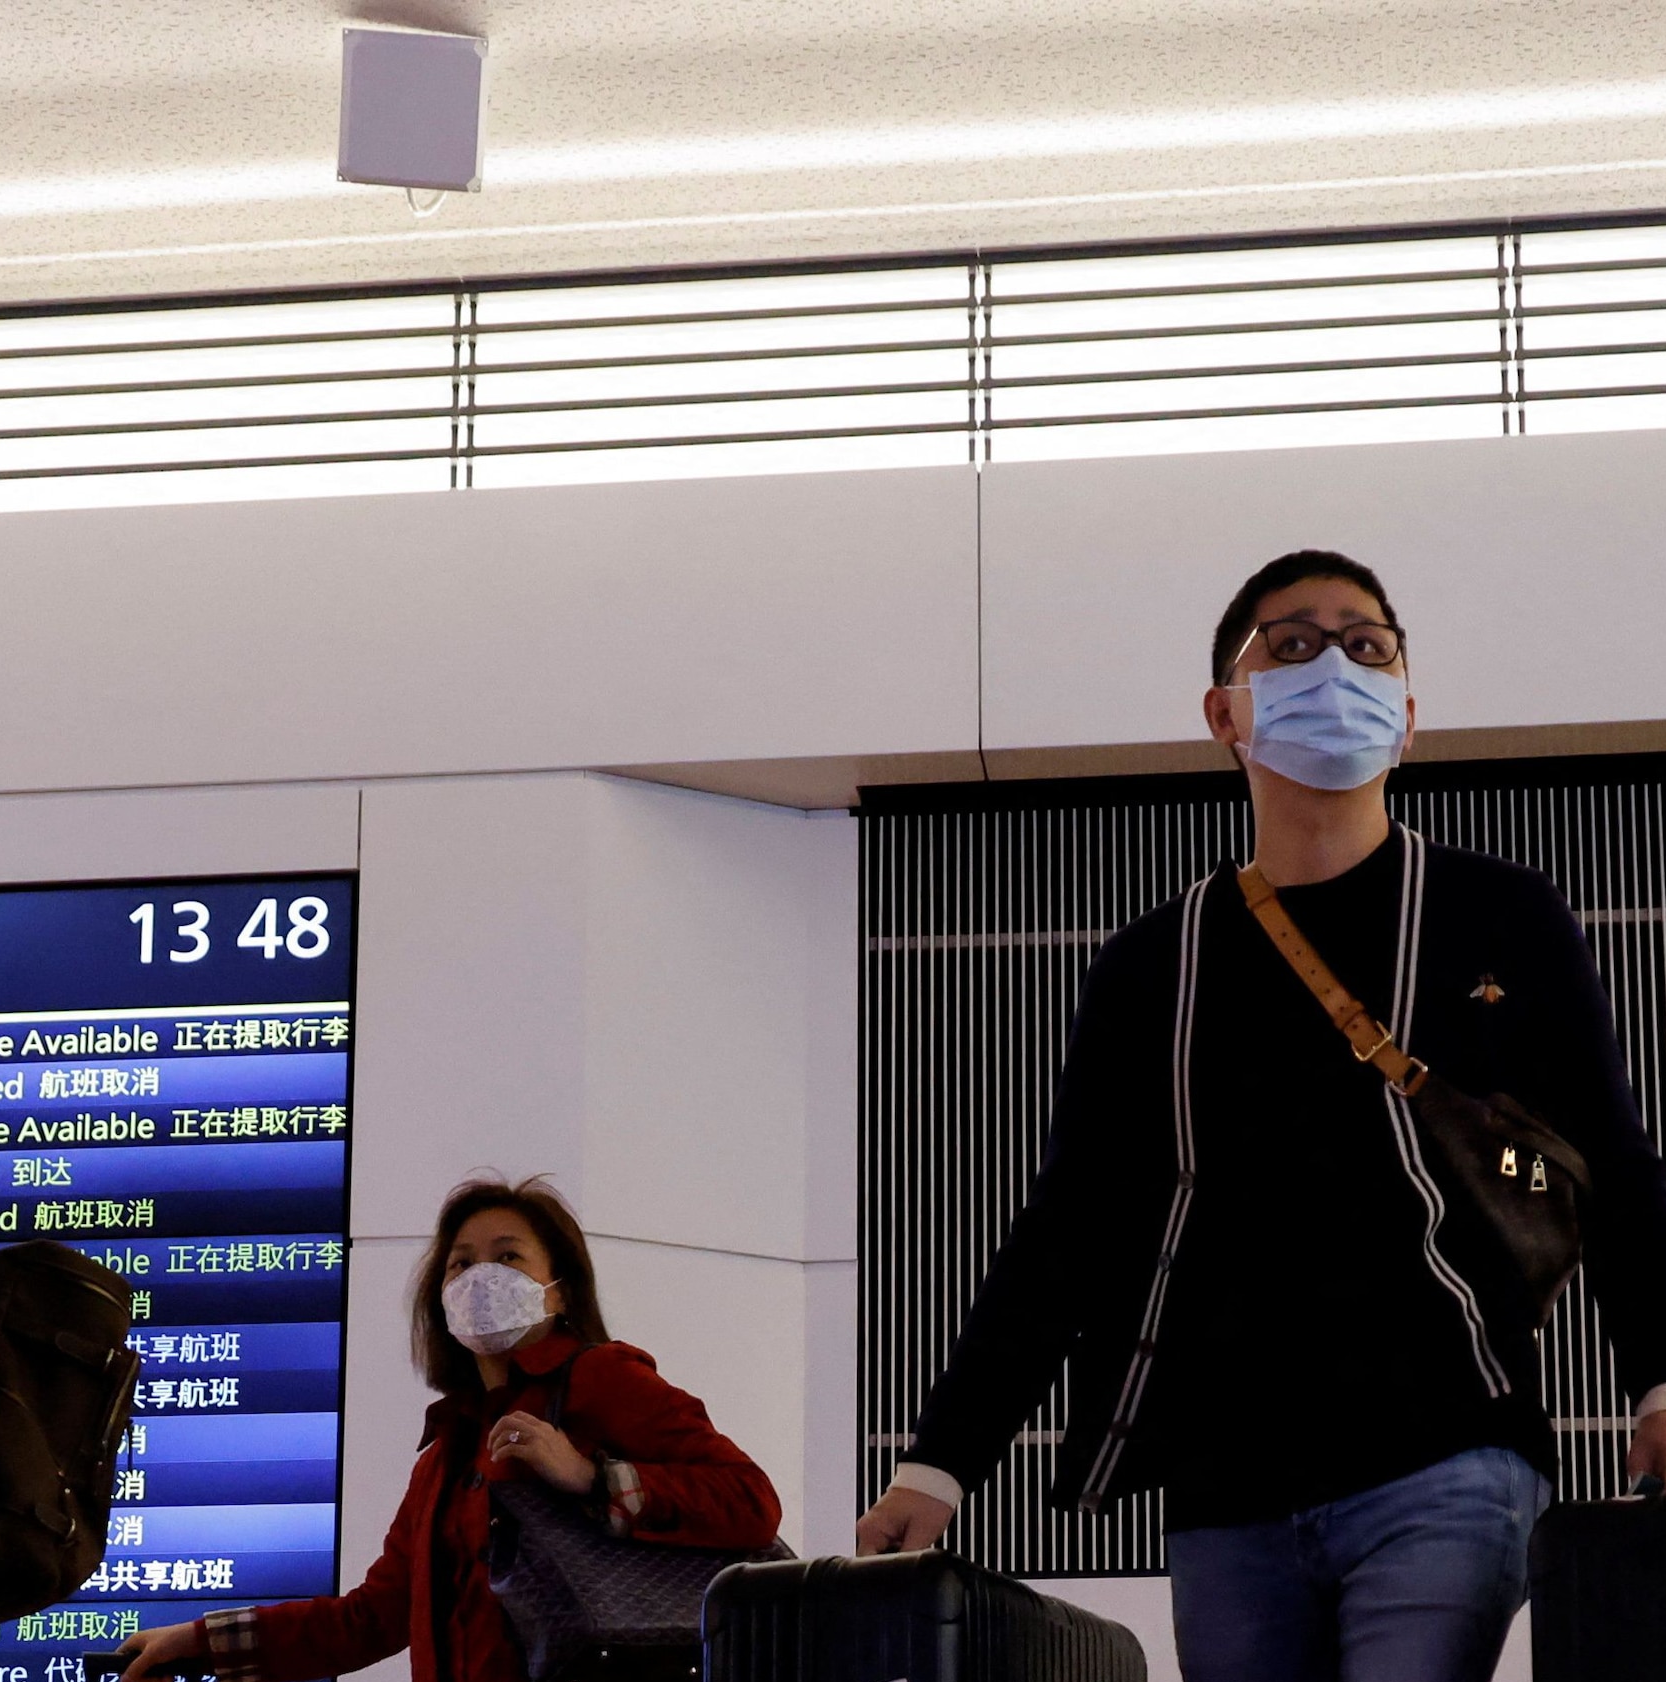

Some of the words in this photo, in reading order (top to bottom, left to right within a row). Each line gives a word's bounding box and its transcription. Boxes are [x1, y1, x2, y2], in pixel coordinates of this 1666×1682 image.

[130, 902, 209, 963] 13
[237, 897, 329, 958] 48
[21, 1025, 158, 1055] Available
[173, 1018, 349, 1050] 正在提取行李
[40, 1066, 158, 1098] 航班取消
[18, 1112, 154, 1142] Available
[171, 1104, 346, 1137] 正在提取行李
[13, 1157, 71, 1186] 到达
[35, 1199, 153, 1230] 航班取消
[167, 1240, 342, 1273] 正在提取行李
[17, 1610, 138, 1641] 航班取消
